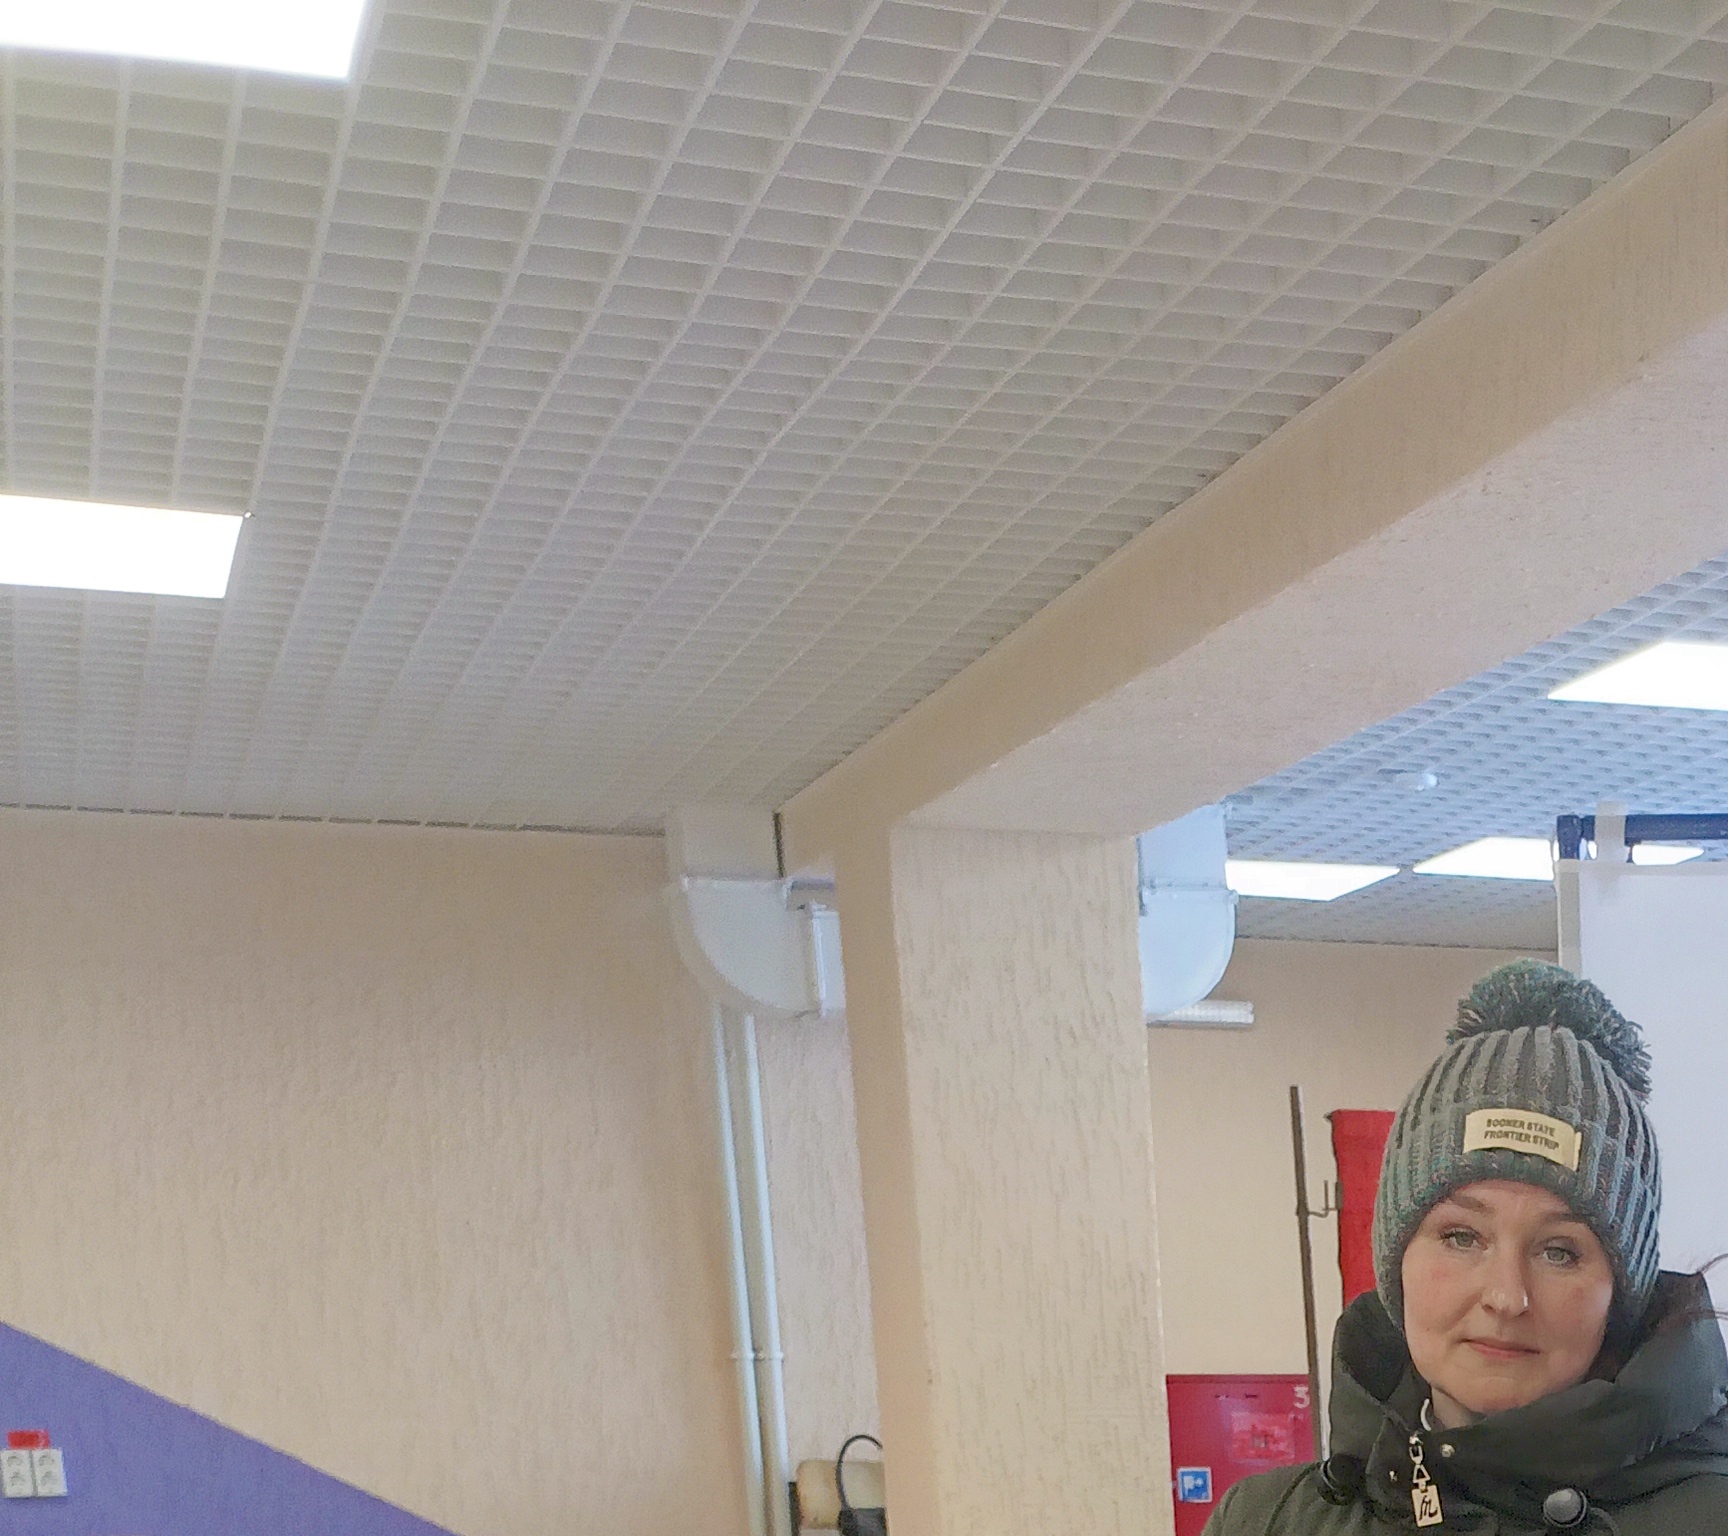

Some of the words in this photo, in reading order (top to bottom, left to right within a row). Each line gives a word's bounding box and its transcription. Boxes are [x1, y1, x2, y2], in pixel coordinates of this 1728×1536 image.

[1486, 1118, 1525, 1130] SOONER
[1527, 1121, 1556, 1136] STATE
[1484, 1130, 1531, 1144] FRONTIER
[1532, 1135, 1560, 1150] STRIP
